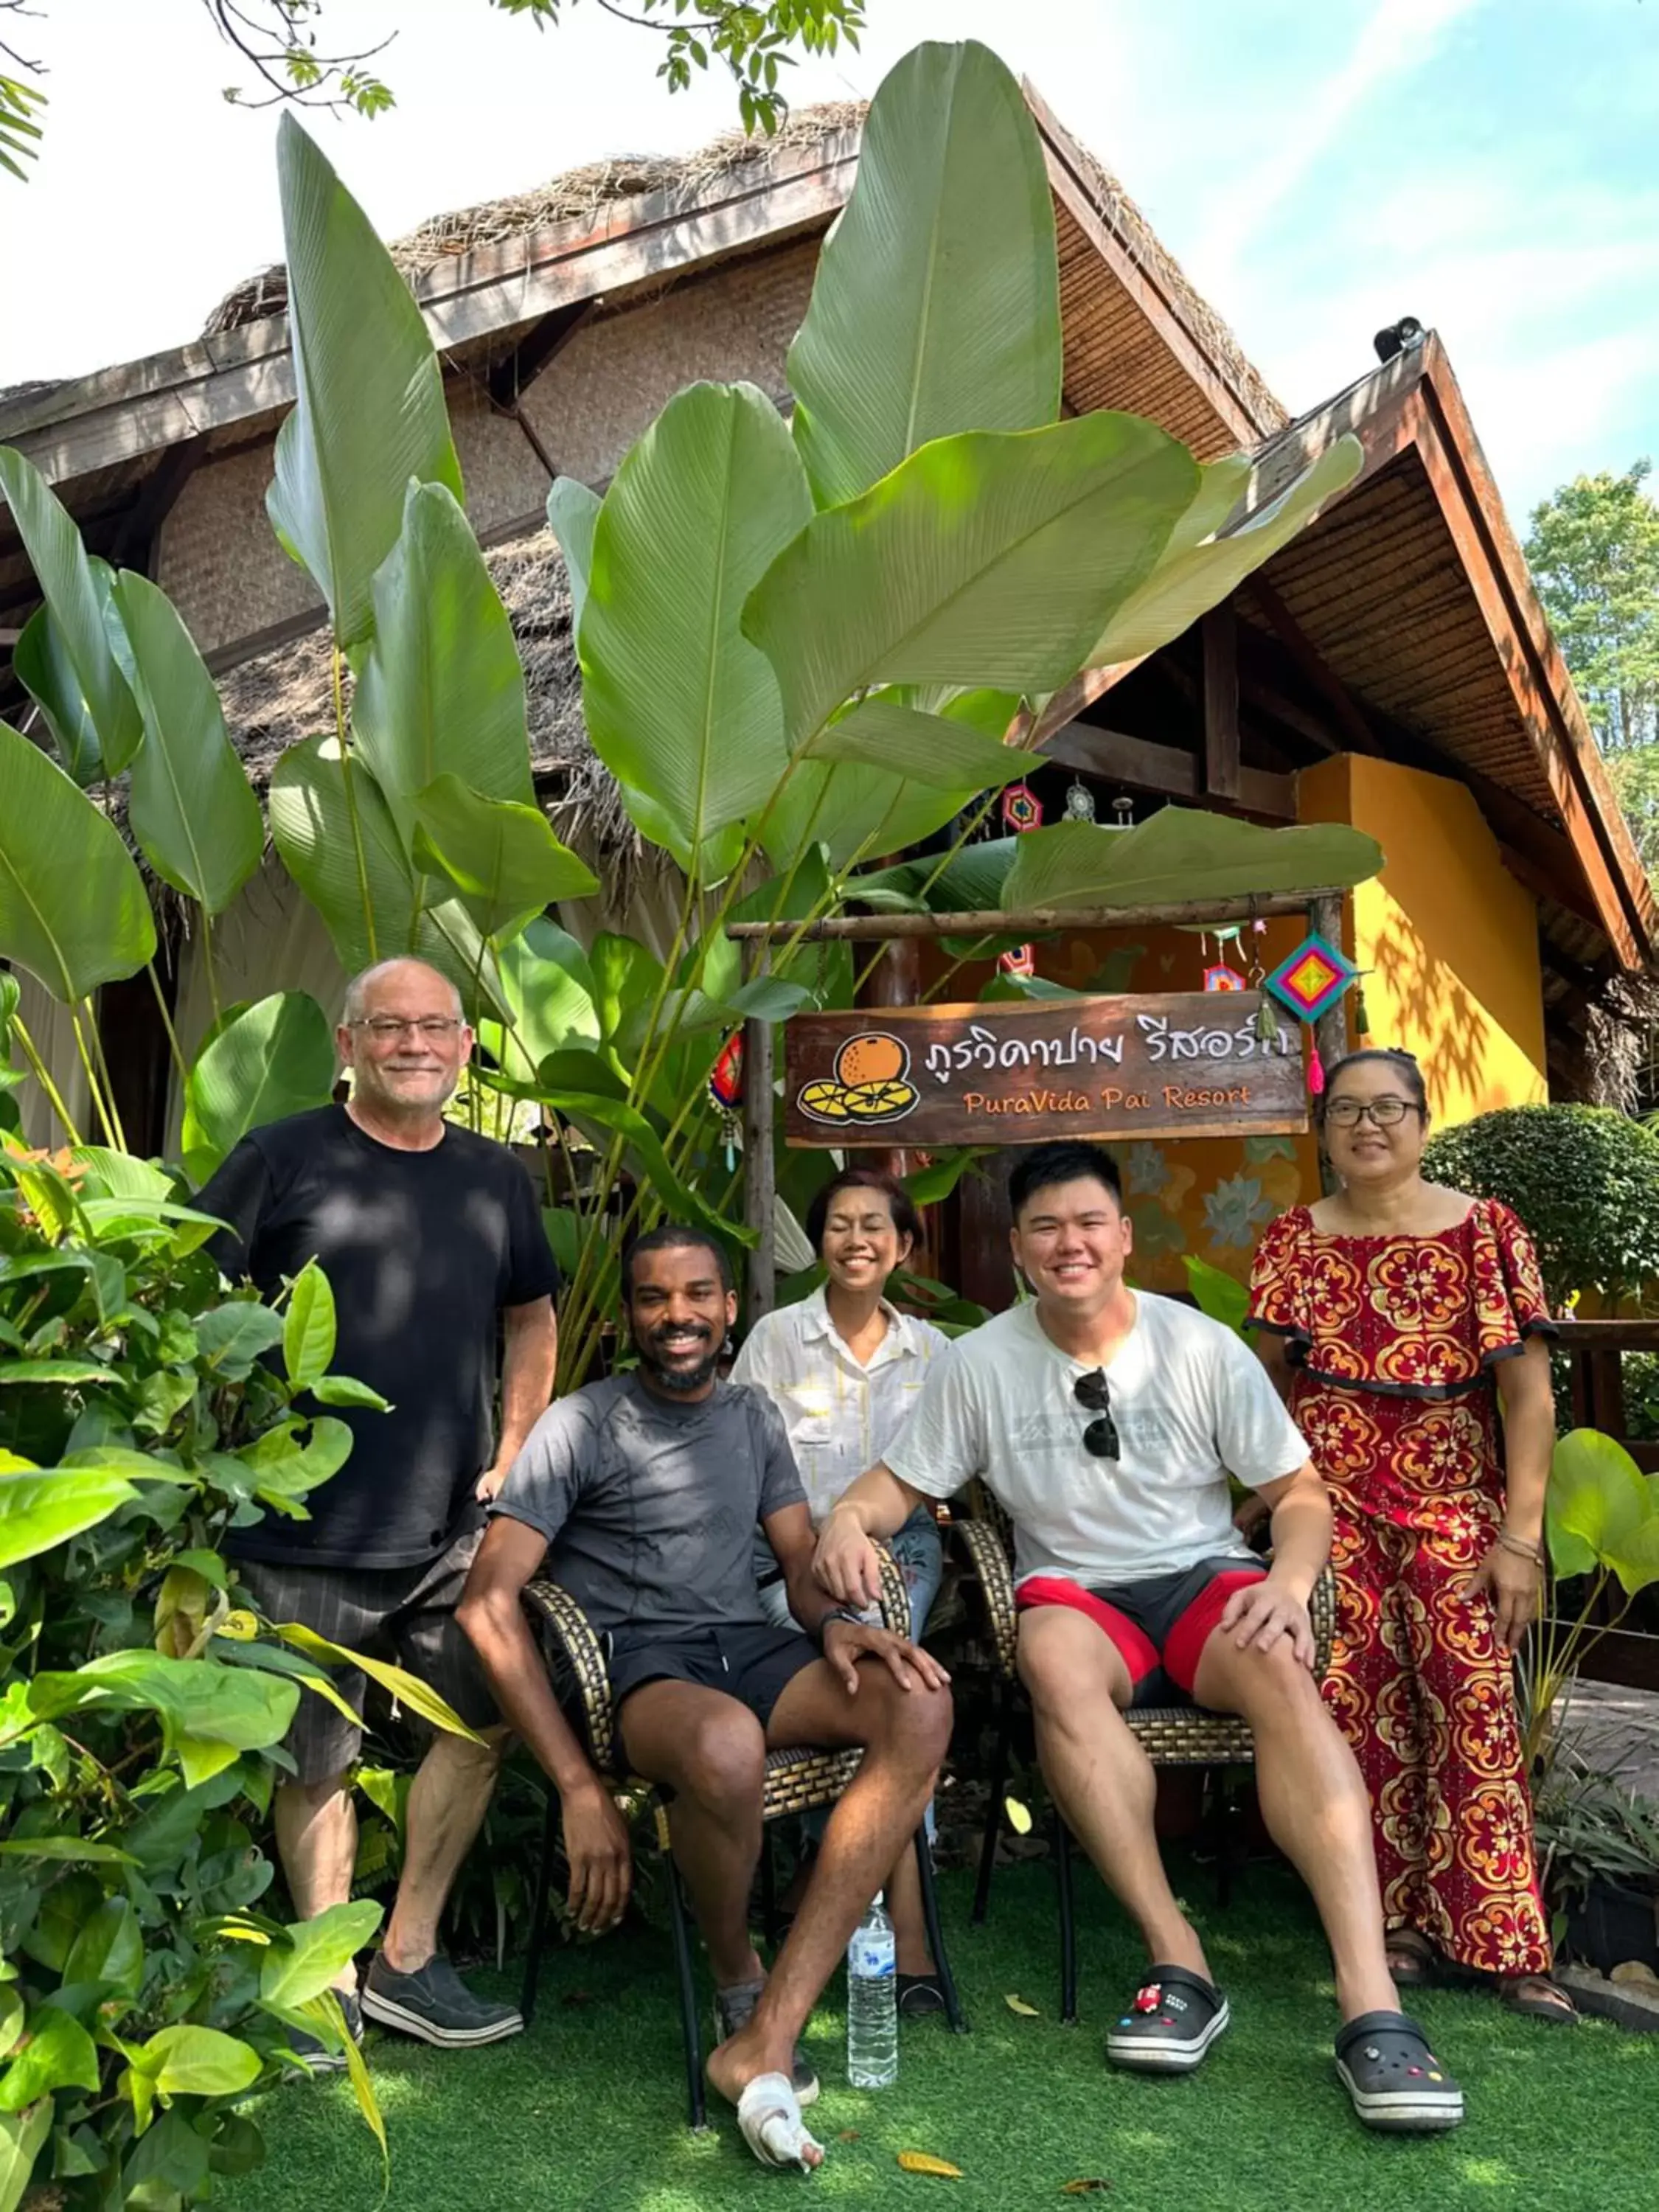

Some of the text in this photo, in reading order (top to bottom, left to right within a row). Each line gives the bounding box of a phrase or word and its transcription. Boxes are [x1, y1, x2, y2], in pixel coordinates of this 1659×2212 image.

[963, 1085, 1251, 1114] PuraVida Pai Resort
